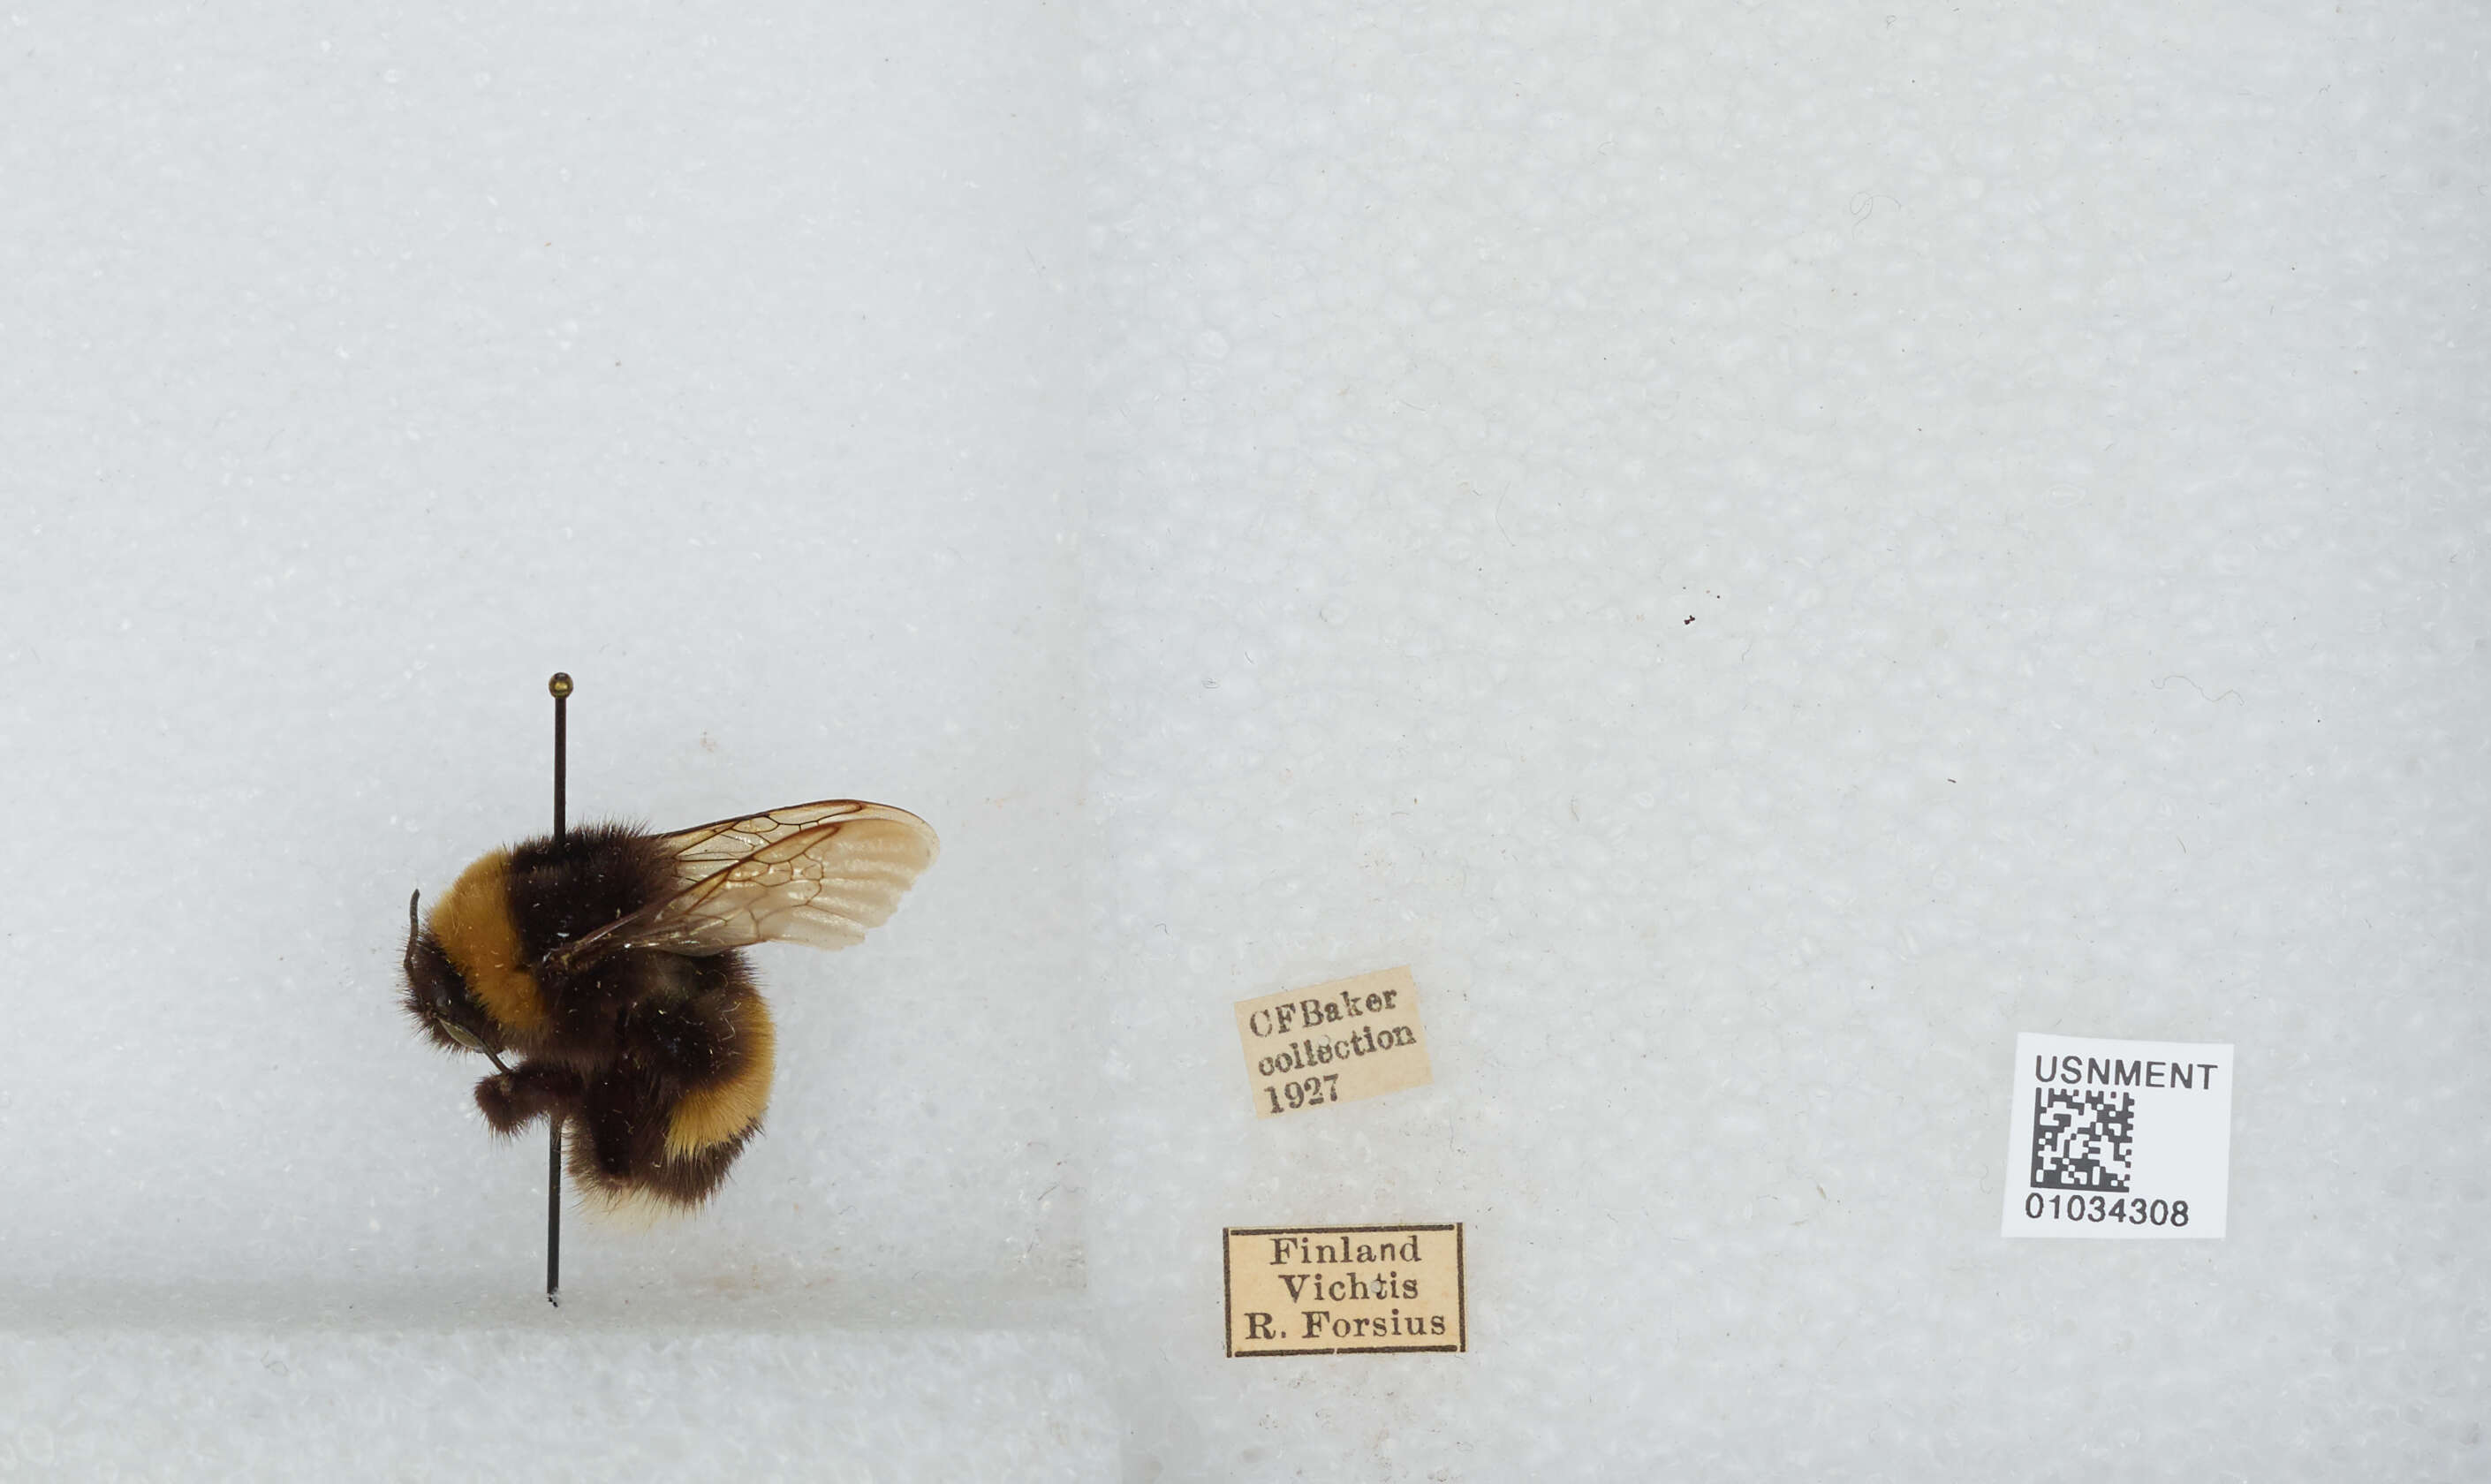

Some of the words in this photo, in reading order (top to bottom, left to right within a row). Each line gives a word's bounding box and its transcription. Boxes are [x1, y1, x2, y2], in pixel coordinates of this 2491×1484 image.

[1258, 1025, 1417, 1077] collection
[2035, 1055, 2219, 1090] USNMENT
[1263, 1073, 1339, 1114] 1927
[2025, 1192, 2189, 1227] 01034308
[1269, 1235, 1422, 1265] Finland
[1278, 1270, 1419, 1304] Vichtis
[1244, 1312, 1287, 1340] R.
[1301, 1308, 1446, 1339] Forsius
